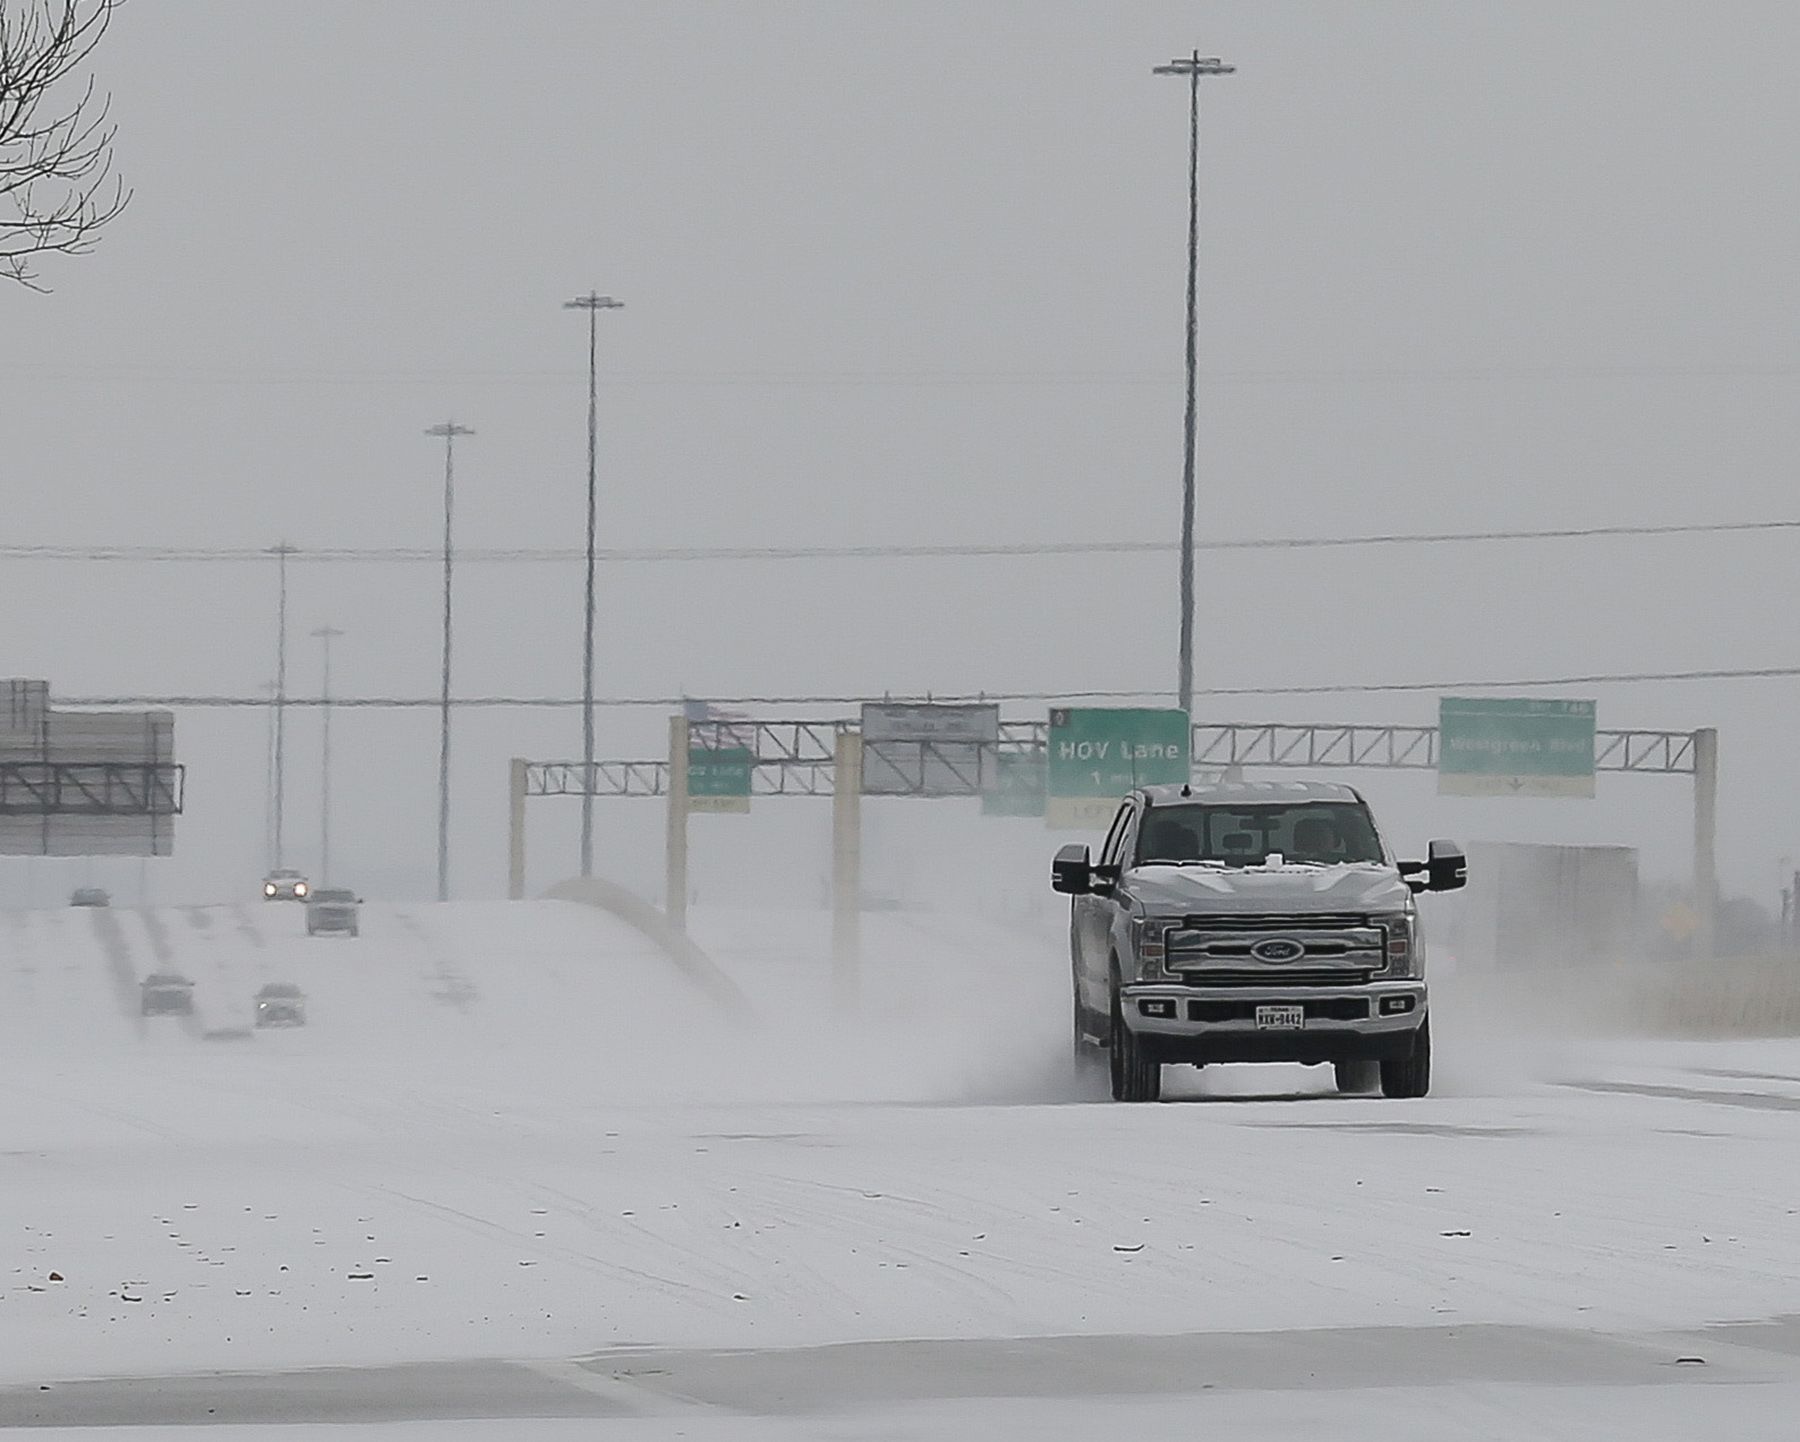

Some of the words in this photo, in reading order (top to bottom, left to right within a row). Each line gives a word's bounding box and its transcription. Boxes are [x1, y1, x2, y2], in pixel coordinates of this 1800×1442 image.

[1060, 741, 1110, 760] HOV
[1120, 741, 1178, 760] Lane
[1090, 771, 1100, 785] 1
[1264, 944, 1290, 956] Ford
